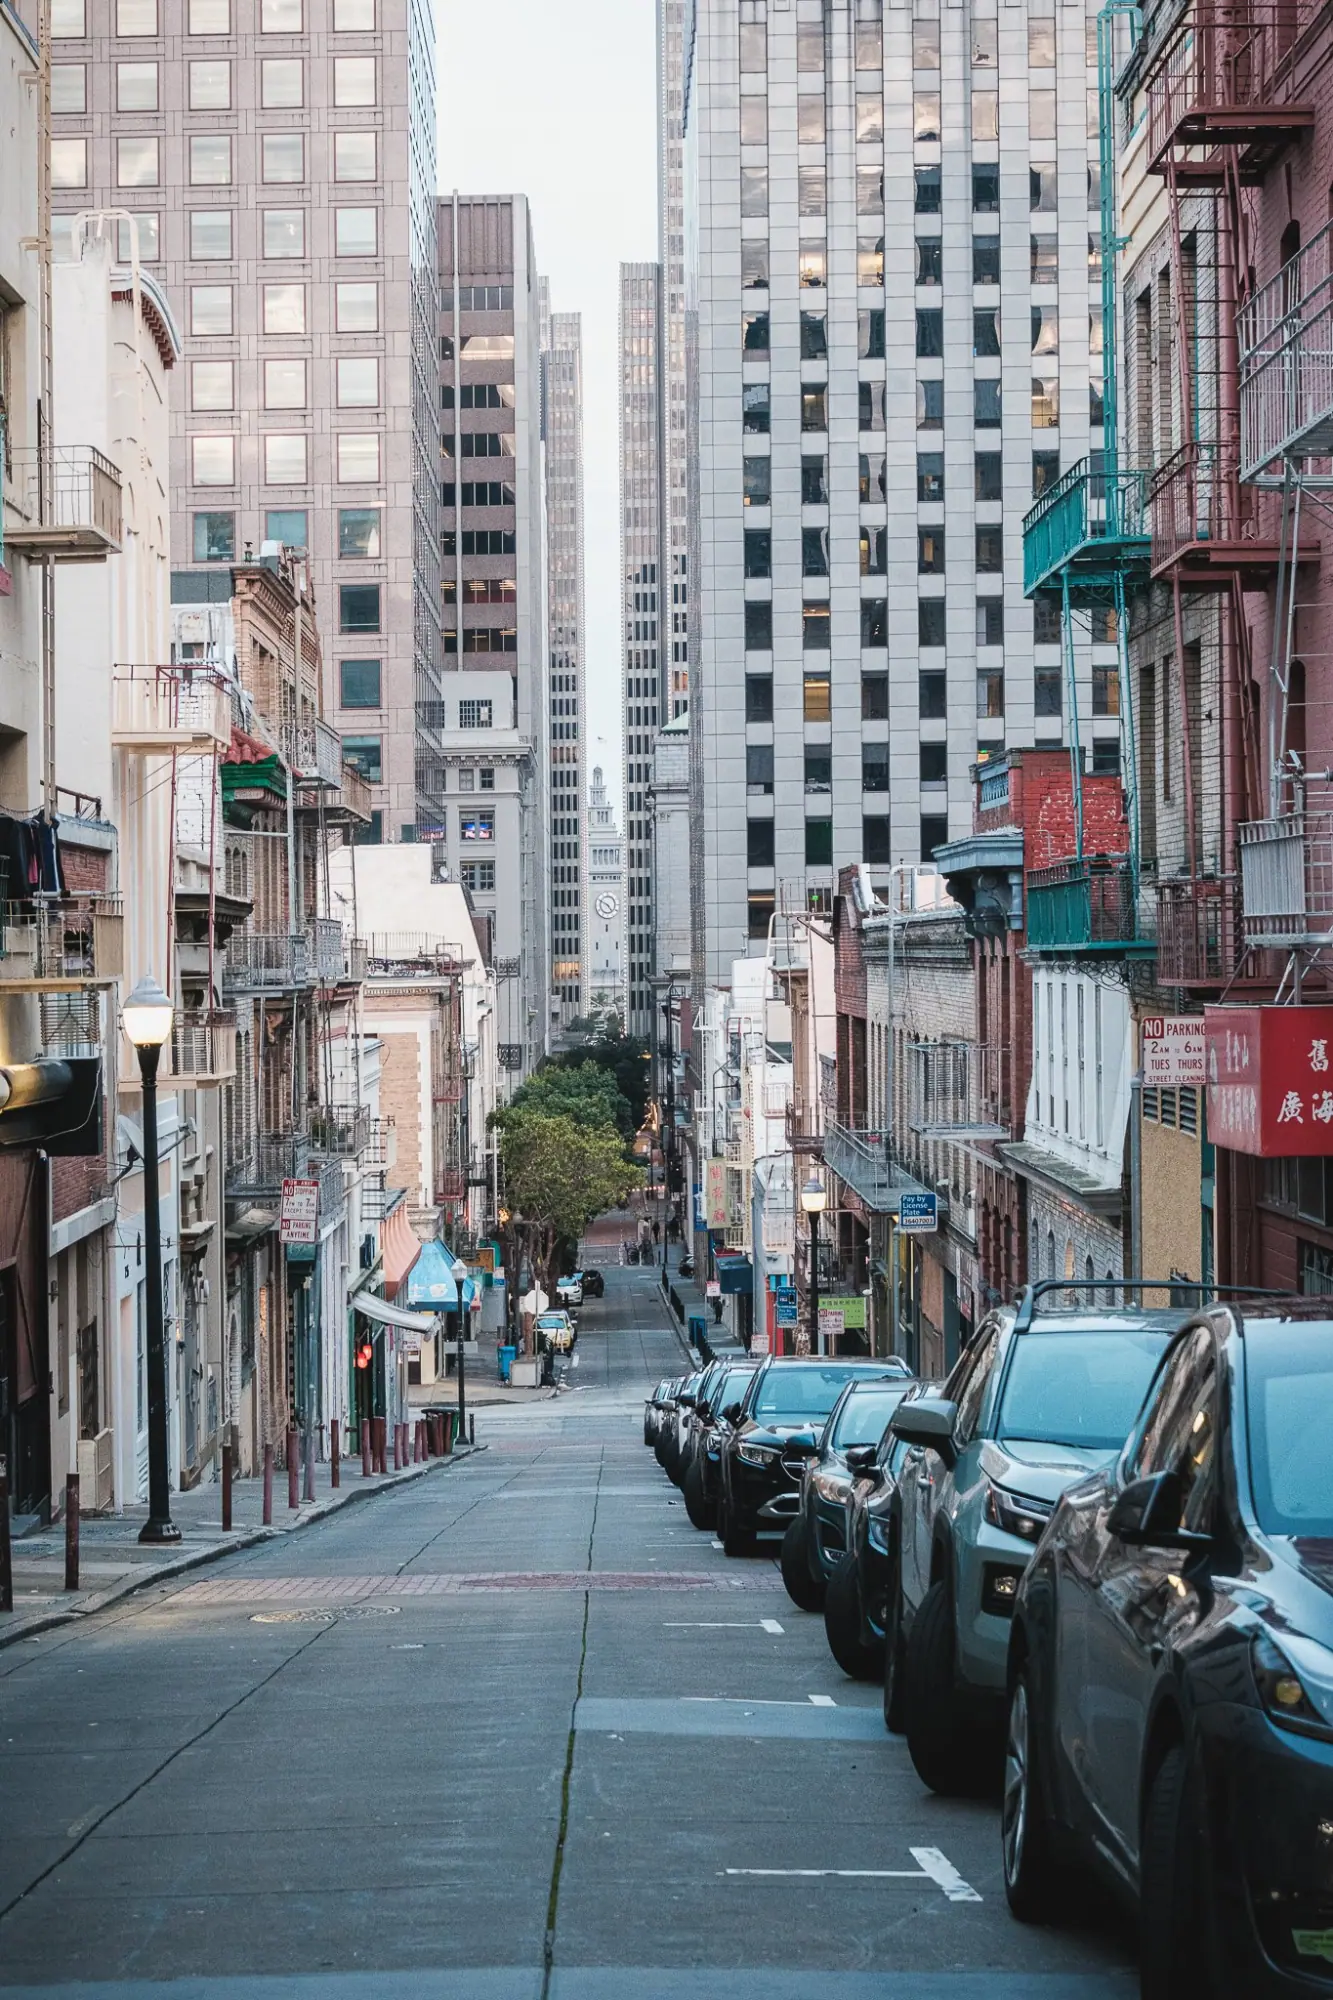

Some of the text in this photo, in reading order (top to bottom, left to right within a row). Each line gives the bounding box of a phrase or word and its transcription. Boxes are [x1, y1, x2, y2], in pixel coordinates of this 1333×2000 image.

[1145, 1020, 1162, 1037] NO
[1151, 1059, 1203, 1070] TUES THURS
[284, 1186, 316, 1196] NO STOPPING
[282, 1221, 312, 1230] NO PARKING
[286, 1231, 310, 1239] ANYTIME
